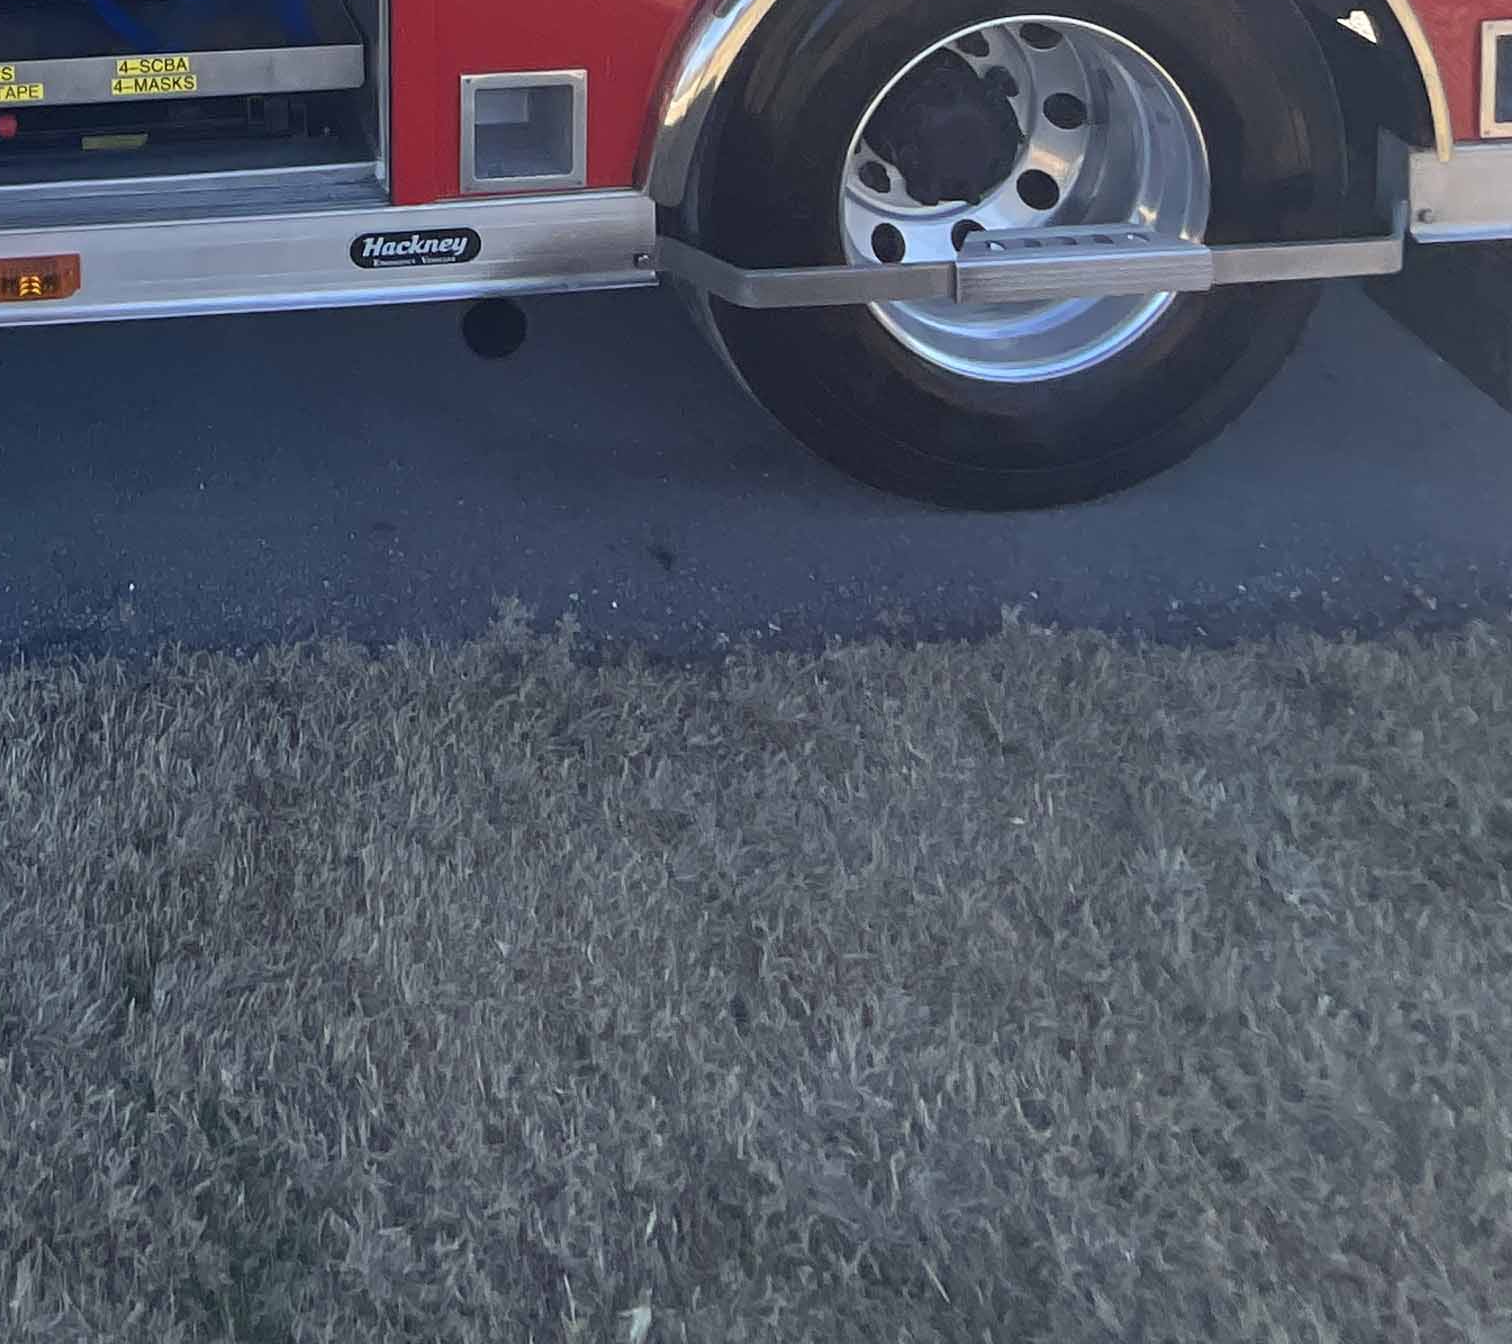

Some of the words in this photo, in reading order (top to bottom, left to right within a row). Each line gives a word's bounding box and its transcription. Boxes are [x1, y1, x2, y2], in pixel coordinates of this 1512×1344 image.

[118, 57, 188, 73] 4-SCBA
[113, 76, 195, 93] 4-MASKS
[362, 234, 468, 258] Hackney
